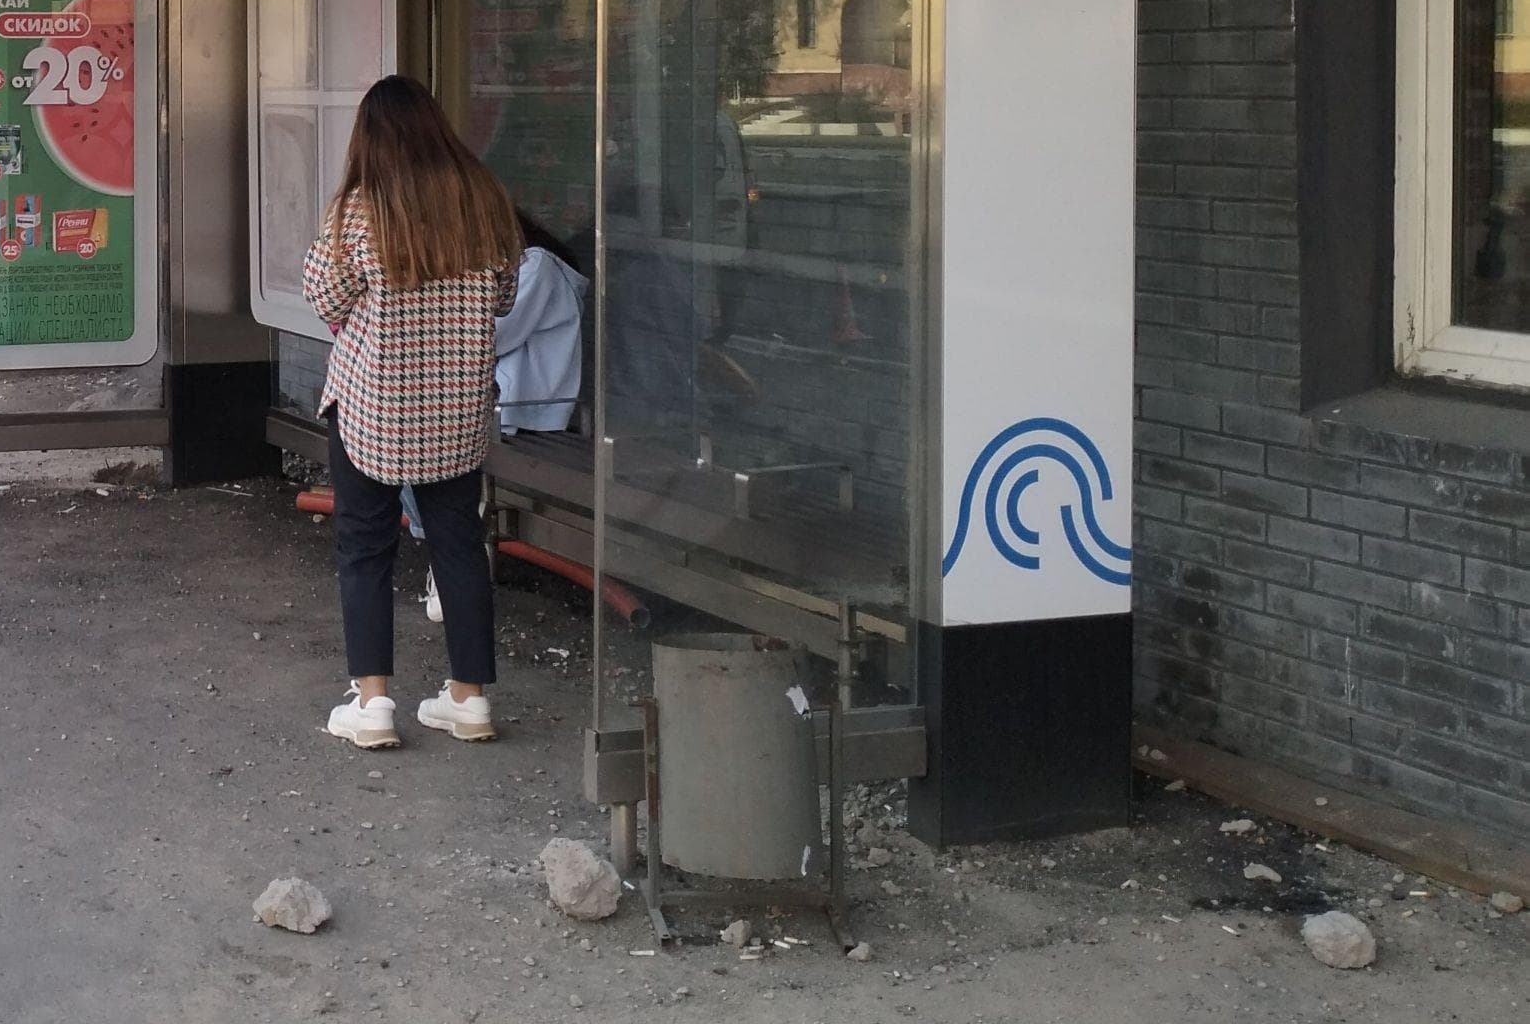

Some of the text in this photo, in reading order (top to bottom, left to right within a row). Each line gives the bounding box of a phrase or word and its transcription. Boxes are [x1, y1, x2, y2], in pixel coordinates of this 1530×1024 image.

[3, 18, 82, 35] СКИДОК
[45, 293, 124, 316] НЕОБХОДИМО
[38, 318, 124, 341] СПЕЦИАЛИСТА
